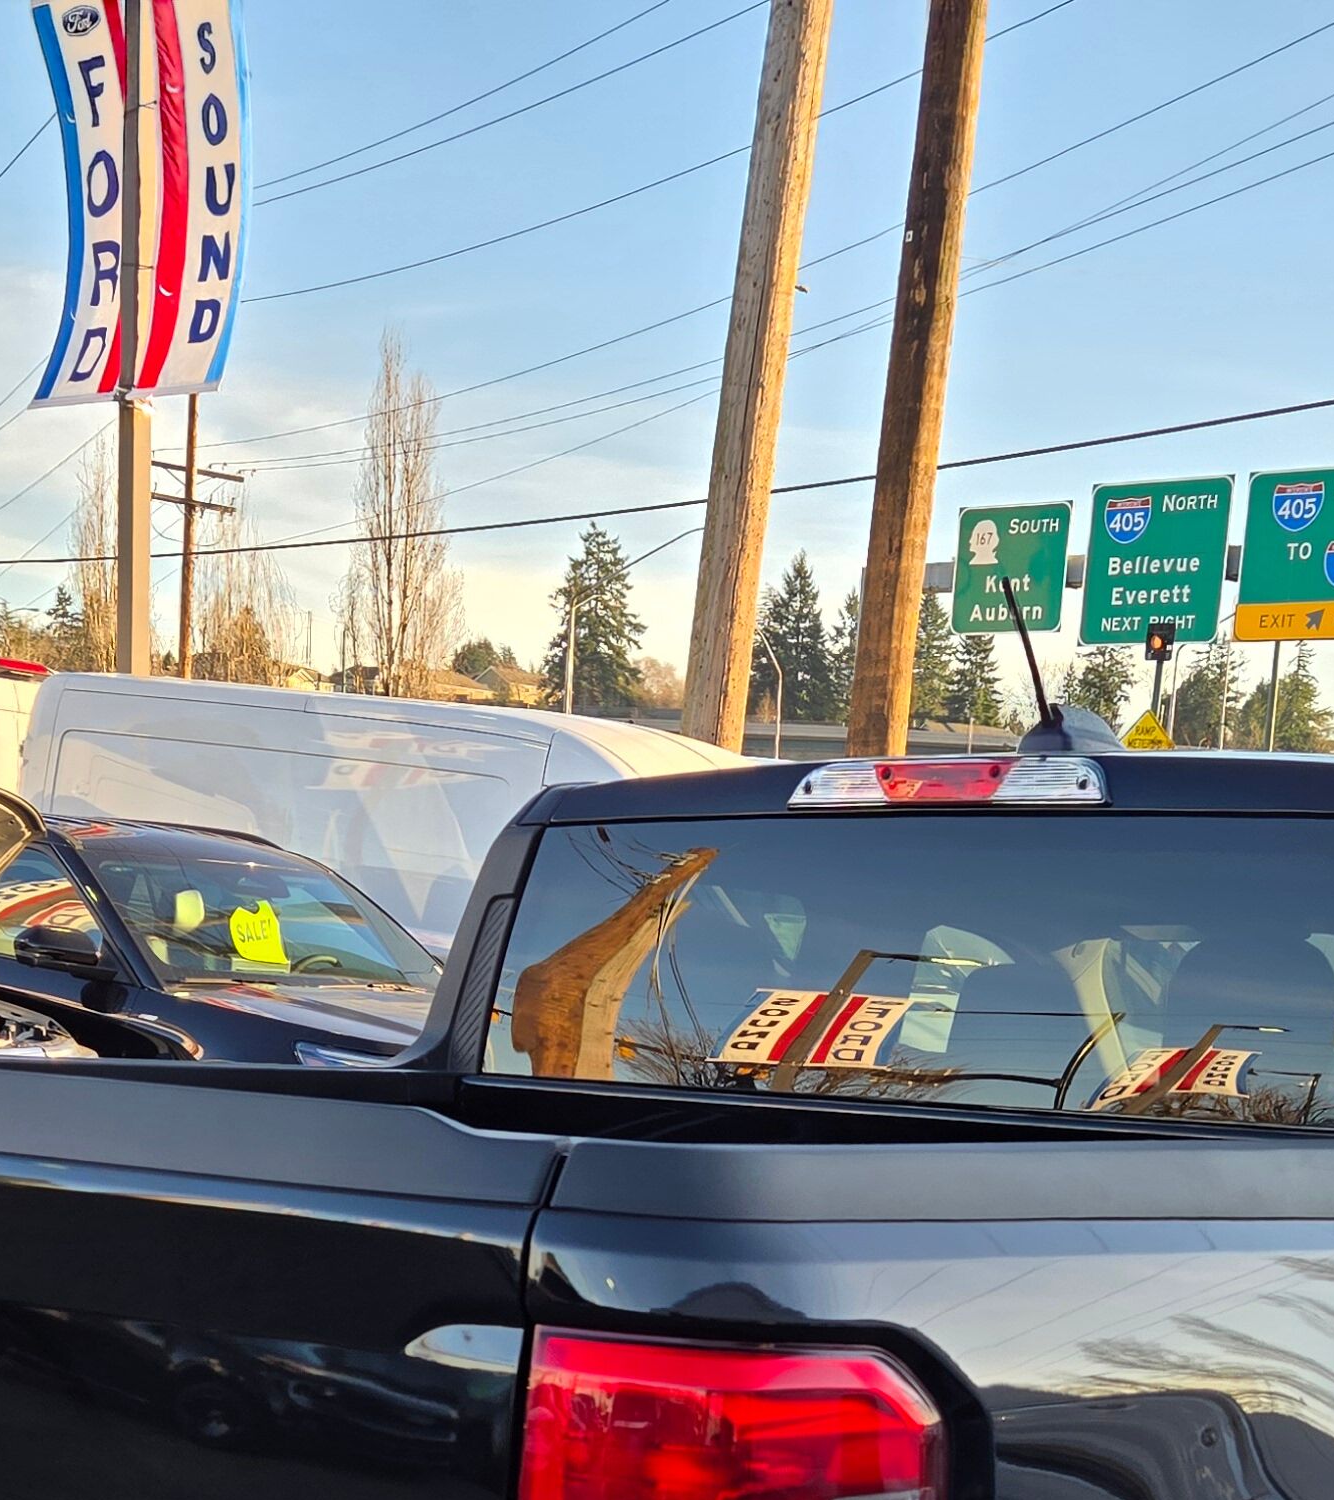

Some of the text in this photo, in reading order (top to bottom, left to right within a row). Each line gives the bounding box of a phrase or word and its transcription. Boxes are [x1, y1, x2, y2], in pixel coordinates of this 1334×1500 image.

[187, 21, 236, 344] SOUND
[69, 55, 121, 383] FORD
[1161, 494, 1219, 513] NORTH
[1277, 497, 1318, 520] 405
[1008, 518, 1060, 535] SOUTH
[1109, 511, 1146, 533] 405
[975, 532, 994, 546] 167
[1286, 542, 1312, 561] TO
[1107, 555, 1201, 577] Bellevue
[1111, 584, 1192, 606] Everett
[969, 603, 1043, 623] Aubrn
[1259, 613, 1296, 629] EXIT
[1100, 615, 1142, 632] NEXT
